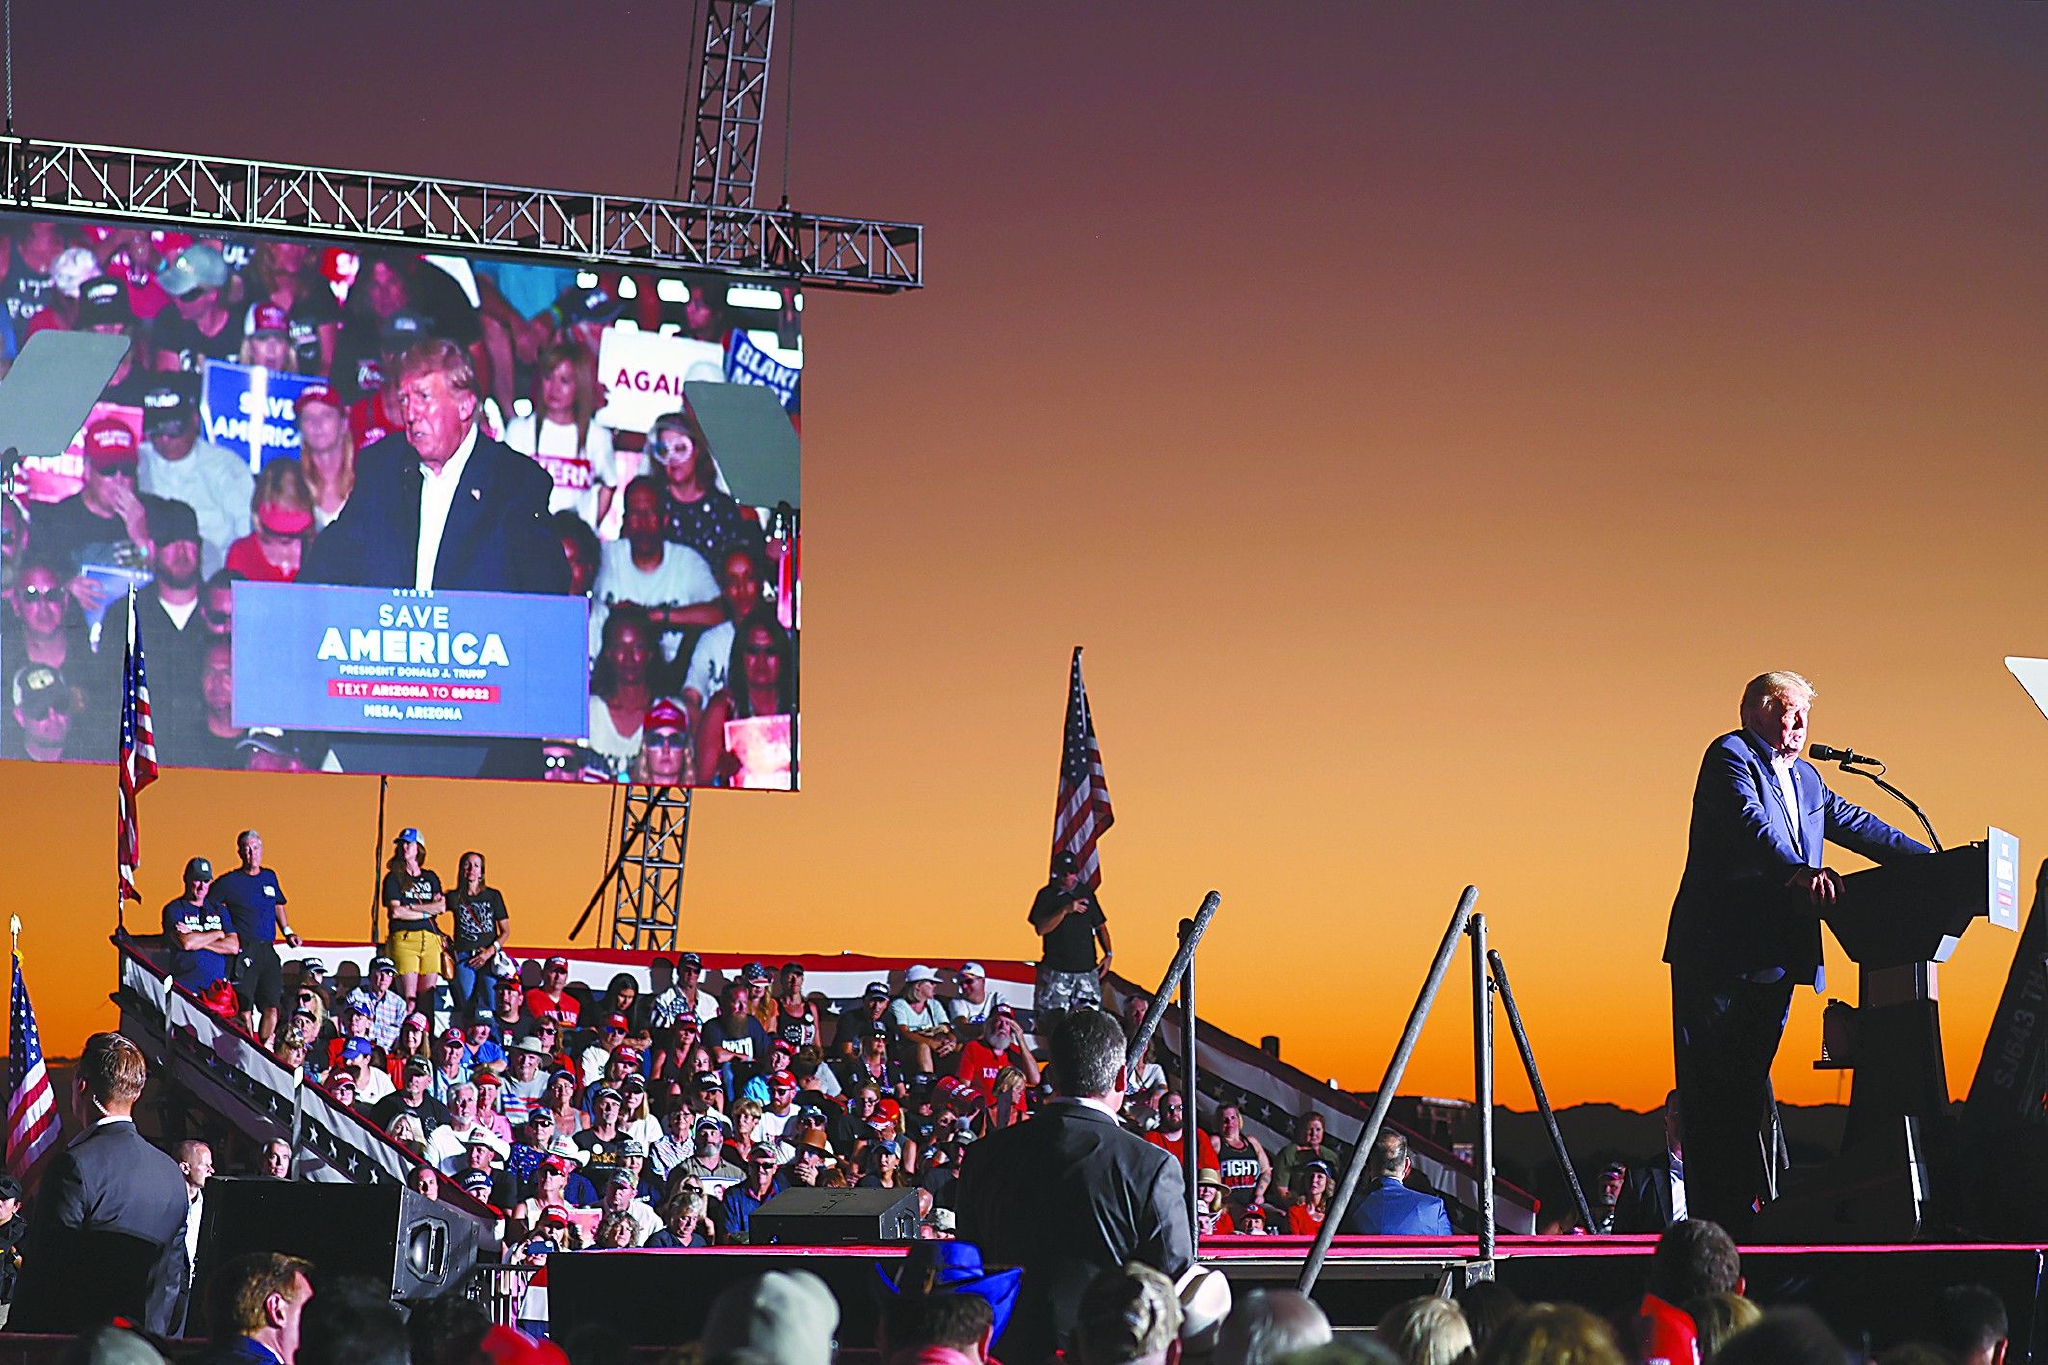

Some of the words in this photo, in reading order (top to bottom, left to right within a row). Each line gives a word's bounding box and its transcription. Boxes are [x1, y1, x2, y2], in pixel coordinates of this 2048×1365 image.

[615, 367, 683, 397] AGAI
[239, 390, 297, 420] SVE
[379, 603, 449, 630] SAVE
[317, 627, 510, 667] AMERICA
[339, 665, 395, 677] PRESIDENT
[397, 666, 440, 678] DONALD
[441, 668, 451, 679] J.
[453, 668, 488, 680] TRUMP
[337, 683, 368, 697] TEXT
[371, 684, 429, 699] ARIZONA
[432, 686, 449, 699] TO
[363, 704, 404, 721] MESA,
[406, 706, 463, 721] ARIZONA
[1993, 1009, 2036, 1089] SJ643
[1220, 1160, 1259, 1177] FIGHT
[464, 1175, 487, 1185] TRUMP
